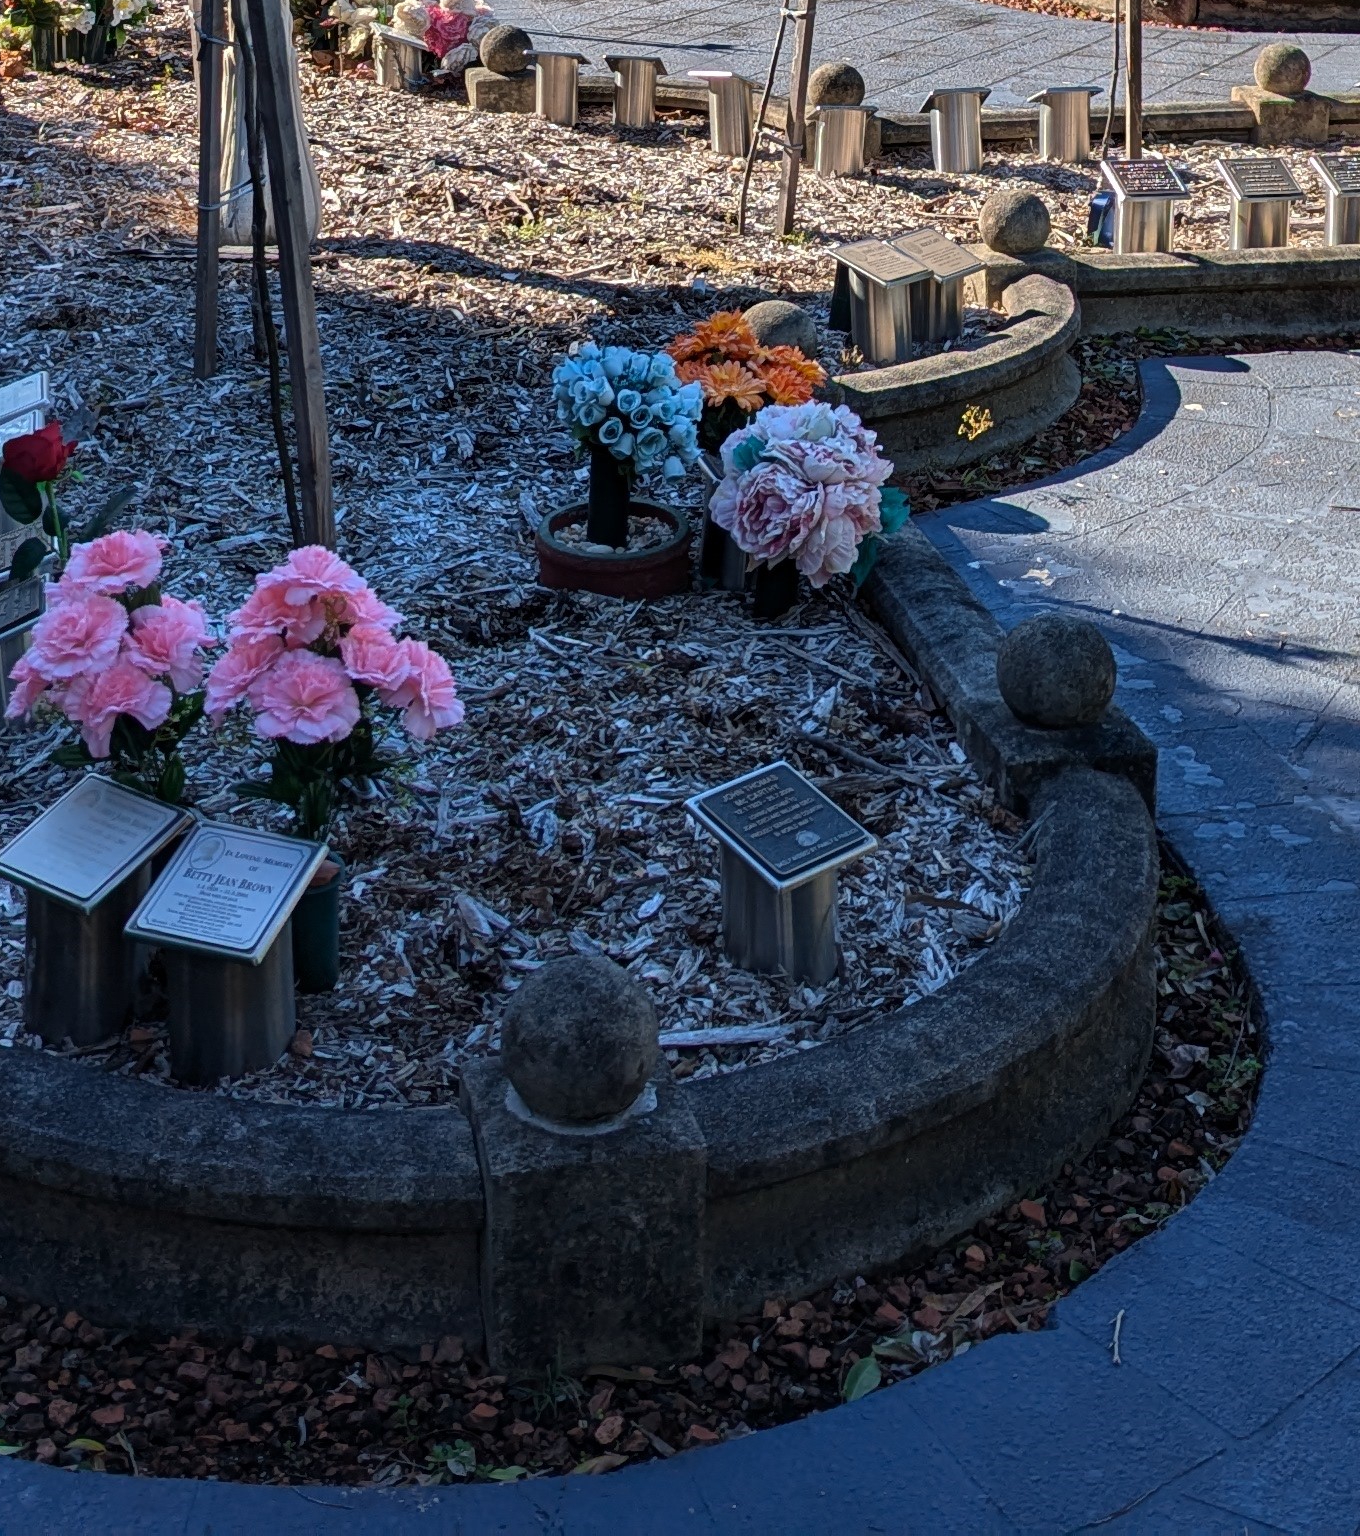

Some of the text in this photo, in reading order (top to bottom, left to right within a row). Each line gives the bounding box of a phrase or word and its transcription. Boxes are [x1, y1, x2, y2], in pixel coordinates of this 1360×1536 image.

[722, 774, 778, 802] JOHN THOMAS
[746, 784, 780, 802] CARTHY
[183, 868, 274, 894] BETTY JEAN BROWN
